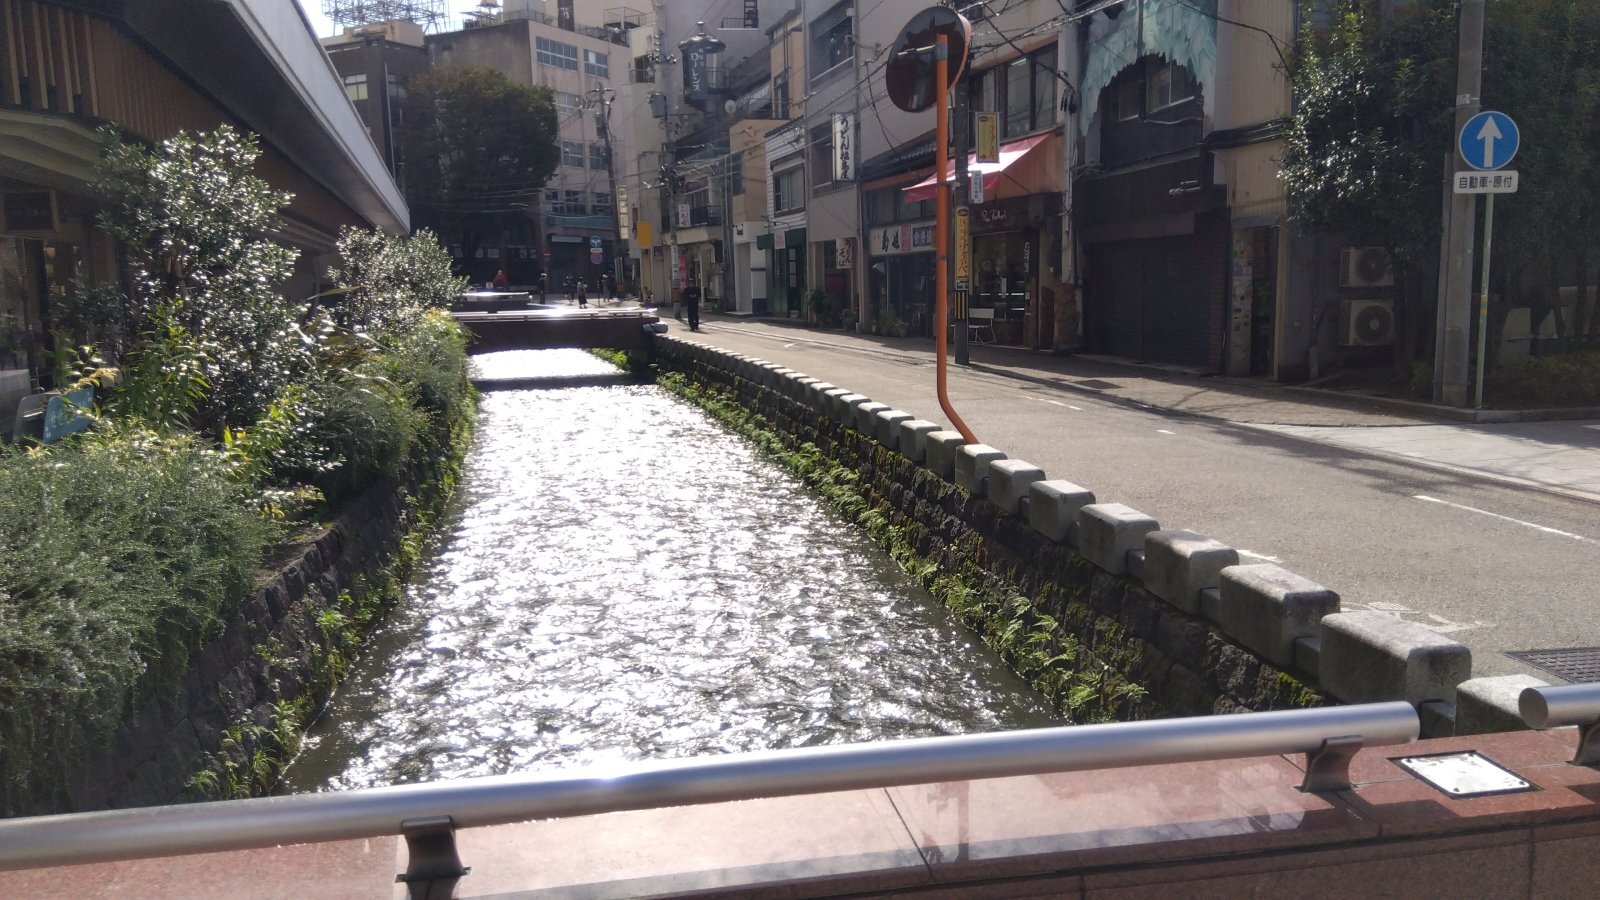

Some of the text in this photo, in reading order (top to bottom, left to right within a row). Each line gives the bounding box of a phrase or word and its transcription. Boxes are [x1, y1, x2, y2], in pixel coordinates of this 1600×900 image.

[690, 52, 701, 92] ローレンス
